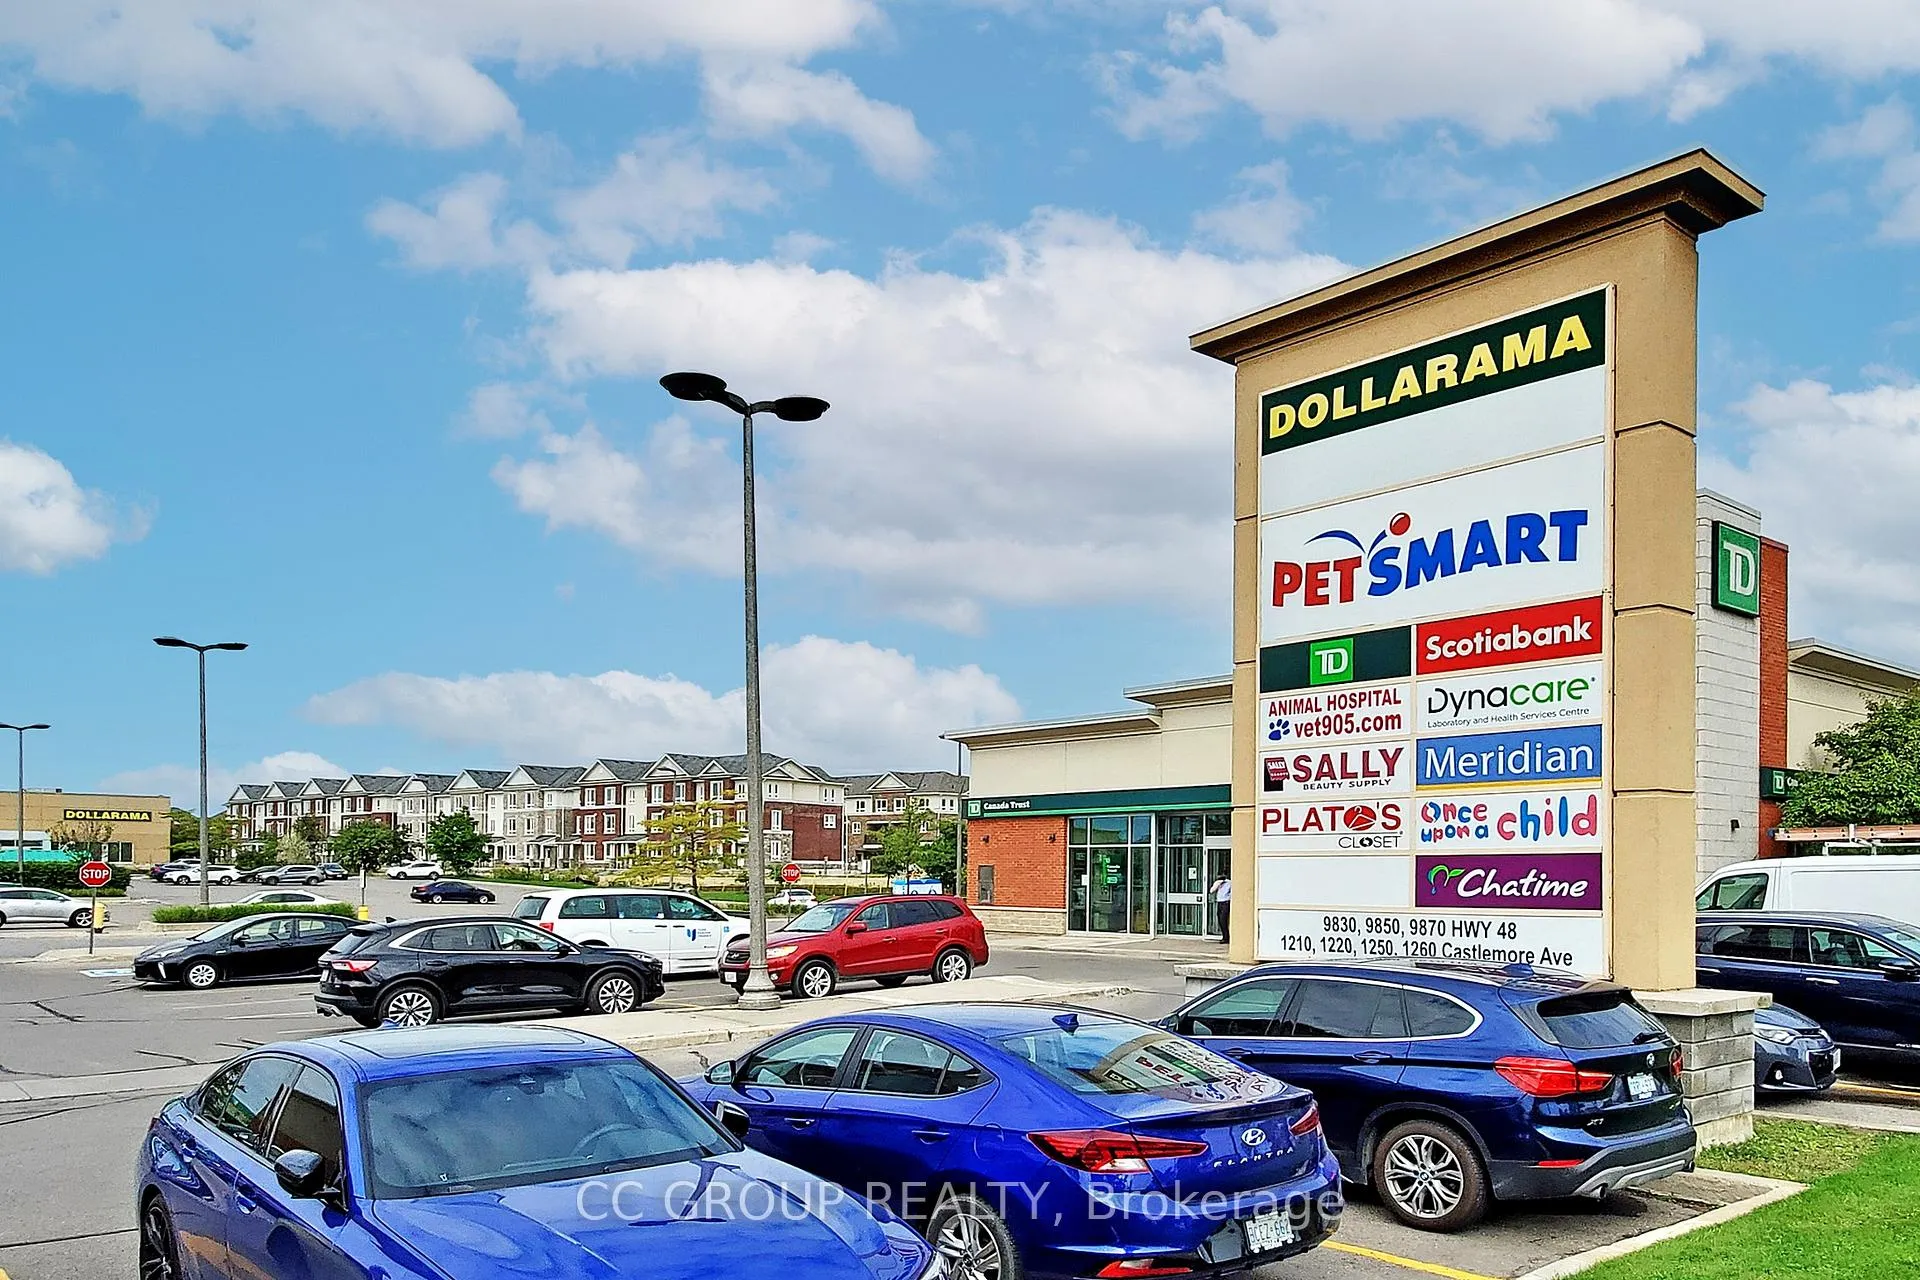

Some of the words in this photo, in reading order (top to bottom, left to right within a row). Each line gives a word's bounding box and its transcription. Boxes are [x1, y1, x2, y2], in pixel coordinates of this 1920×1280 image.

[1269, 315, 1591, 439] DOLLARAMA
[1723, 541, 1755, 596] TD
[1425, 615, 1592, 661] Scotiabank
[1315, 647, 1349, 675] TD
[1268, 696, 1322, 717] ANIMAL
[1327, 688, 1402, 711] HOSPITAL
[1427, 678, 1590, 718] Dynacare
[1294, 713, 1402, 738] vet905.com
[1427, 718, 1472, 729] Laboratory
[1473, 716, 1489, 725] and
[1491, 713, 1519, 723] Health
[1520, 710, 1557, 721] Services
[1559, 707, 1590, 717] Centre
[1292, 747, 1404, 783] SALLY
[1424, 741, 1593, 779] Meridian
[1303, 782, 1343, 791] BEAUTY
[1348, 779, 1391, 788] SUPPLY
[65, 810, 150, 821] DOLLARAMA
[983, 801, 1009, 809] Canada
[1009, 800, 1030, 809] Trust
[1262, 801, 1402, 833] PLATO'S
[1496, 794, 1598, 842] child
[1338, 836, 1402, 849] CLOSET
[1420, 824, 1470, 843] upon
[1474, 824, 1489, 839] a
[82, 869, 110, 879] STOP
[782, 868, 800, 877] STOP
[1456, 868, 1589, 898] Chatime
[1323, 915, 1361, 937] 9830,
[1365, 917, 1405, 938] 9850,
[1409, 918, 1446, 937] 9870
[1451, 920, 1492, 939] HWY
[1496, 921, 1517, 939] 48
[1281, 935, 1316, 955] 1210,
[1320, 936, 1357, 957] 1220,
[1402, 940, 1437, 957] 1260
[1441, 942, 1535, 965] Castlemore
[1539, 946, 1573, 966] Ave
[1213, 1147, 1294, 1168] ELANTRA
